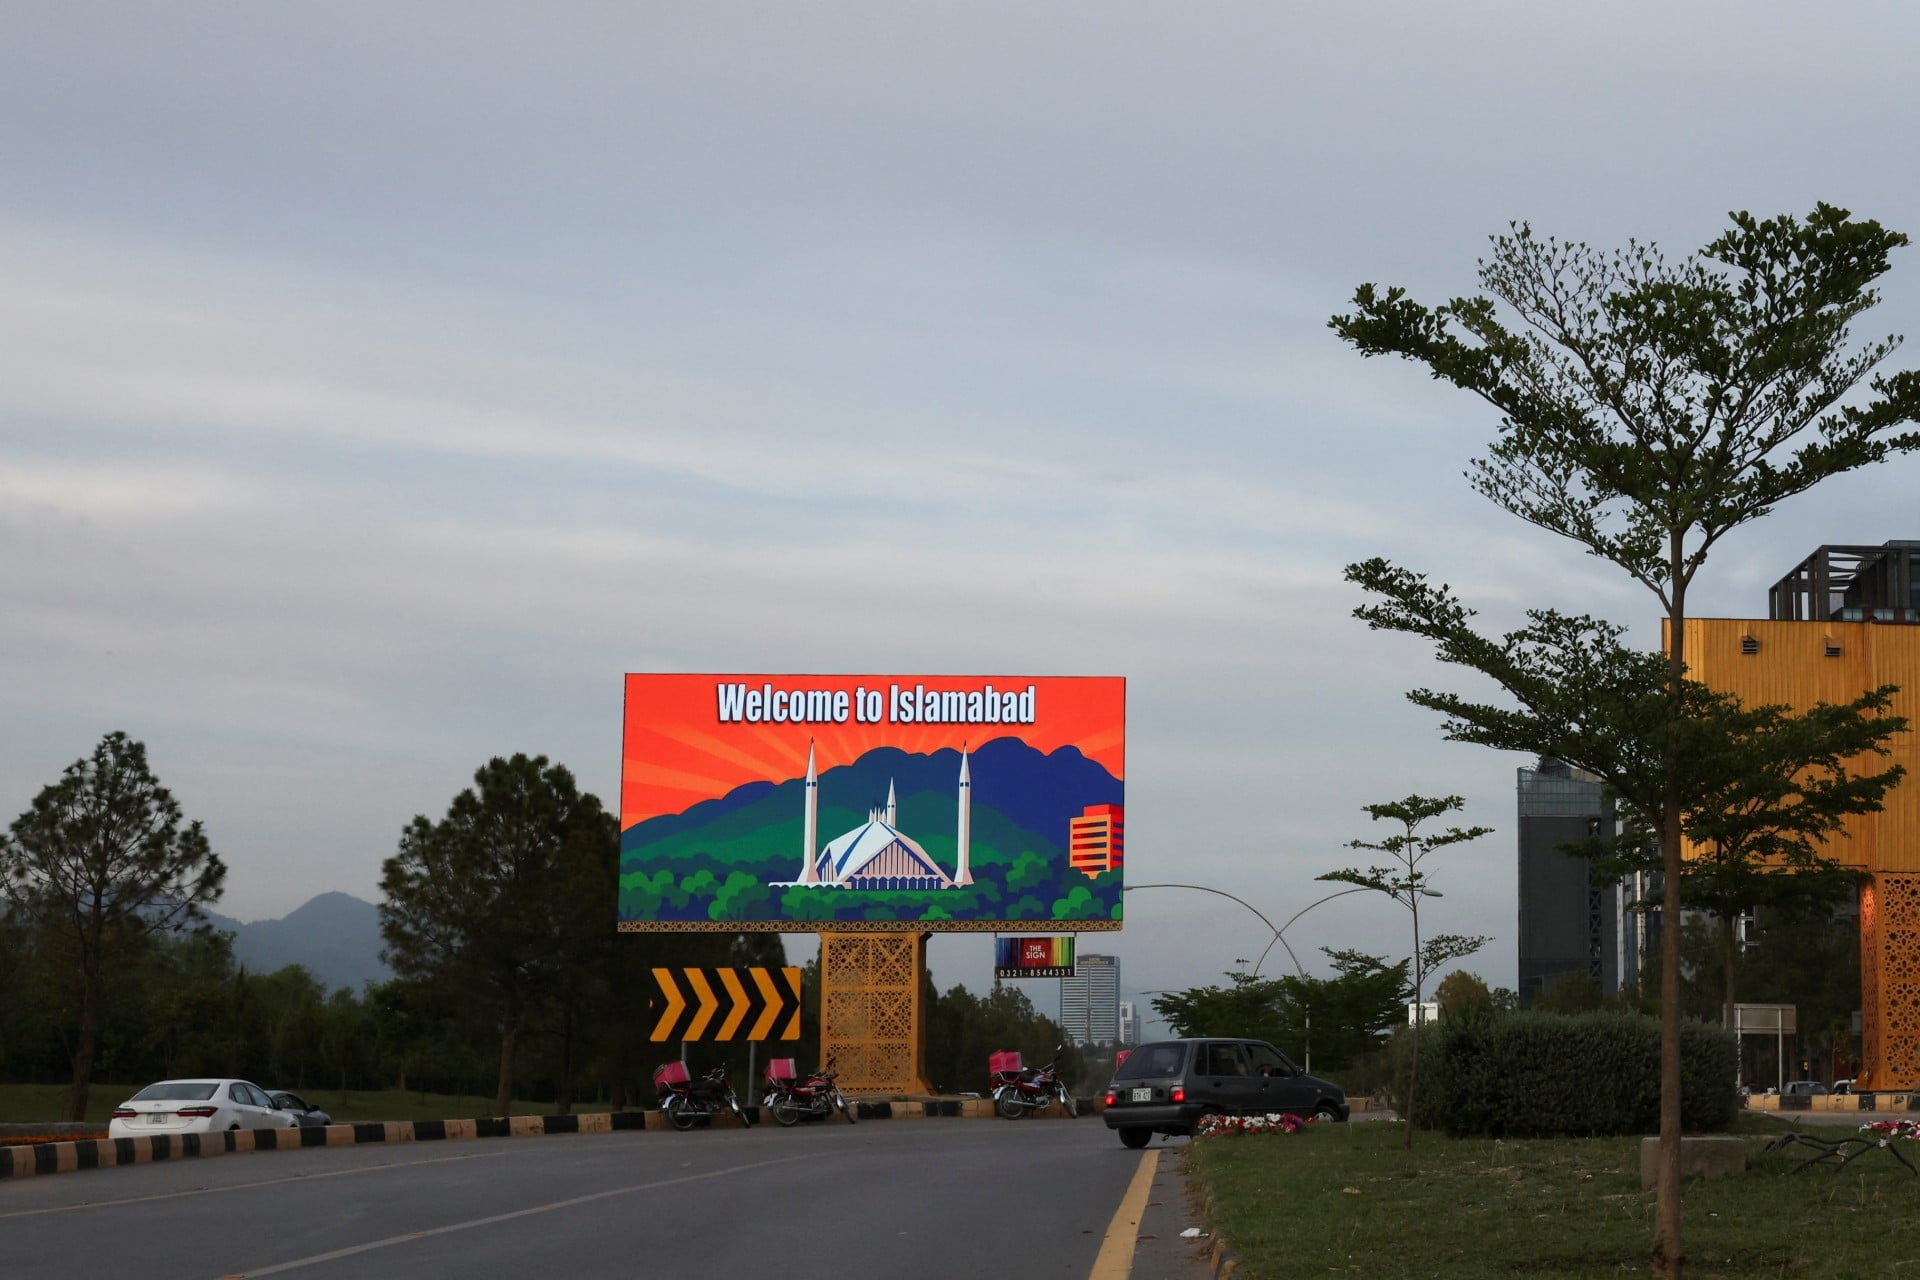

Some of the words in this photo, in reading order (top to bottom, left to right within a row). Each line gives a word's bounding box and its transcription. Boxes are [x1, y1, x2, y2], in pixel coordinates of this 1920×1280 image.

[717, 683, 849, 722] Welcome
[856, 687, 883, 723] to
[890, 684, 1036, 723] Islamabad
[1025, 951, 1046, 959] SIGN
